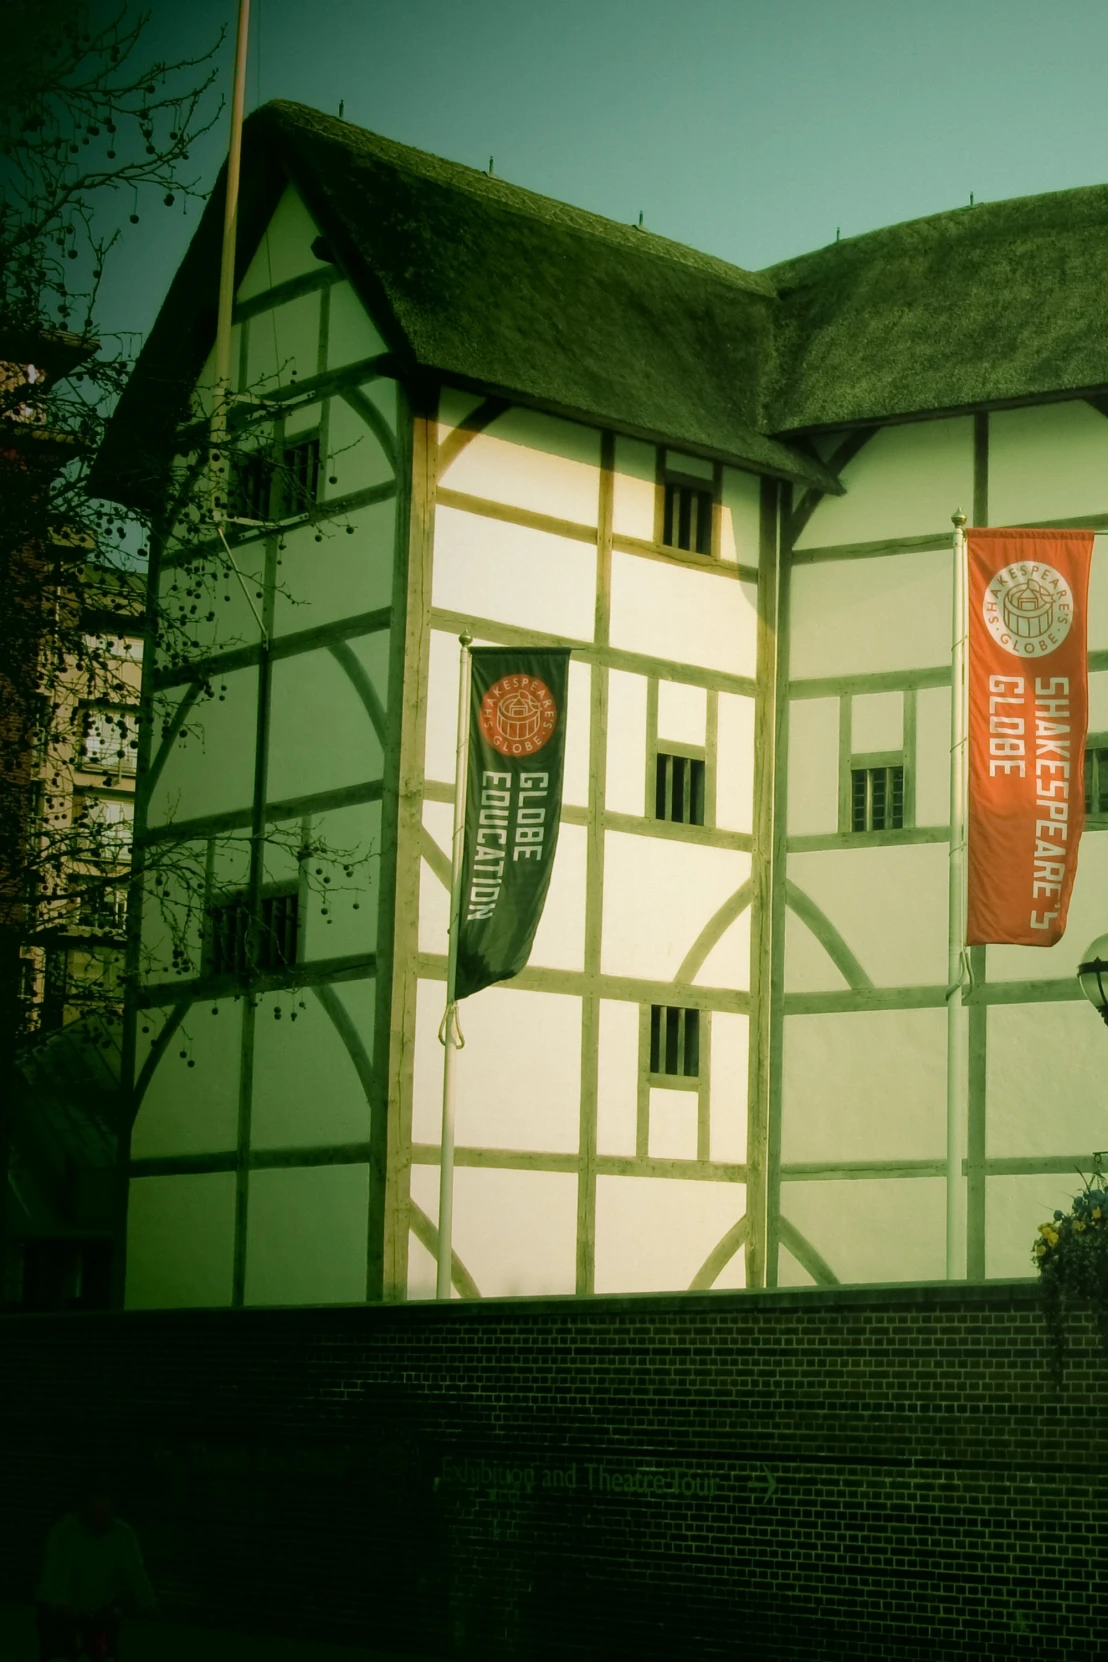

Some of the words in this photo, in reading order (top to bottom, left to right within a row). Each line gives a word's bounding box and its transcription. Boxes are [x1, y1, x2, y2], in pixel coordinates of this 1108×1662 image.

[987, 565, 1070, 625] SHAKESPEARE'S
[999, 633, 1059, 654] GLOBE
[484, 678, 553, 729] SHAKESPEARE'S
[989, 675, 1025, 778] GLOBE
[493, 735, 543, 754] GLOBE
[513, 772, 549, 862] GLOBE
[1030, 677, 1071, 930] SHAKESPEARE'S
[467, 771, 512, 921] EDUCATION
[441, 1456, 534, 1484] Exhibition
[542, 1462, 577, 1489] and
[584, 1463, 663, 1494] Theatre
[667, 1466, 720, 1497] Tour
